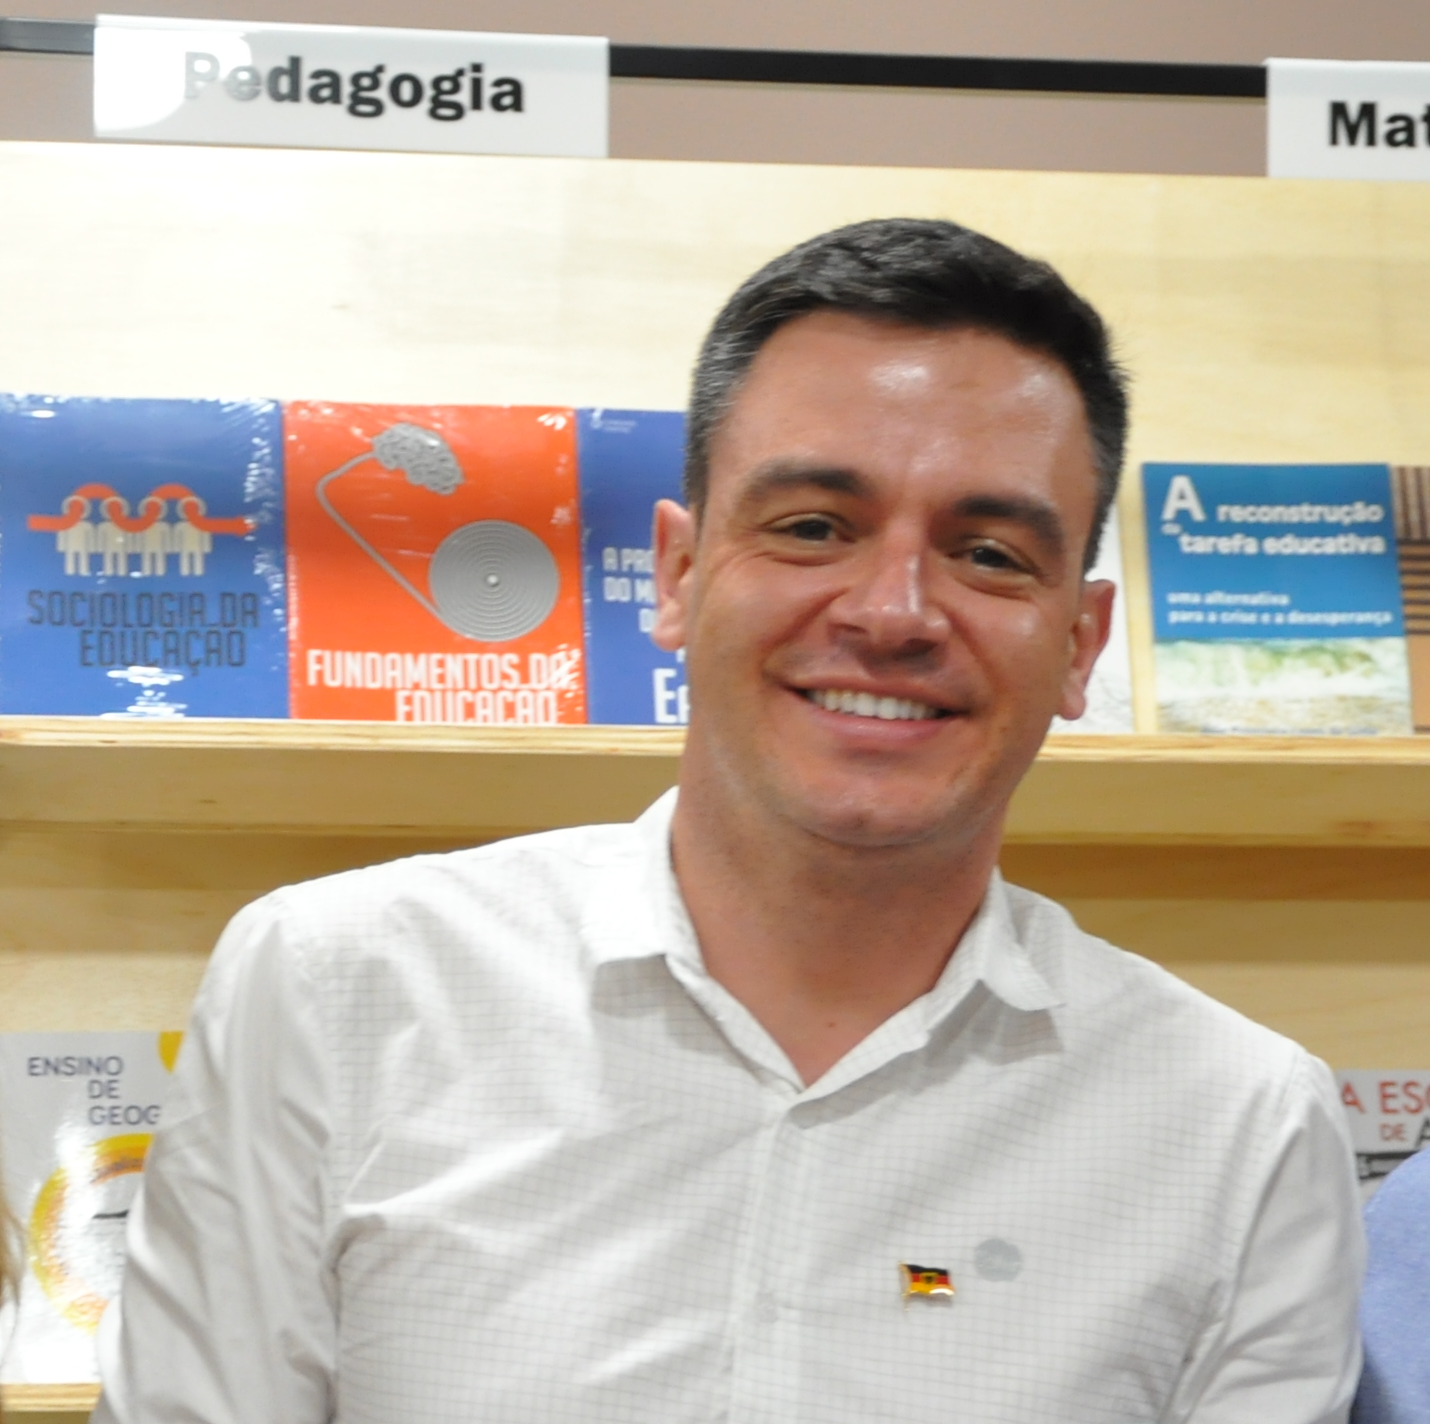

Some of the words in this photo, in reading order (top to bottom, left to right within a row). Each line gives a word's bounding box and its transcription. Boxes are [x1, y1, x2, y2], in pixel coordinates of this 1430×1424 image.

[183, 50, 524, 121] Pedagogia
[1216, 501, 1385, 525] reconstrução
[1178, 533, 1259, 555] tarefa
[1262, 533, 1387, 555] educativa
[28, 1056, 123, 1078] ENSINO
[89, 1080, 121, 1099] DE
[89, 1105, 162, 1125] GEOG
